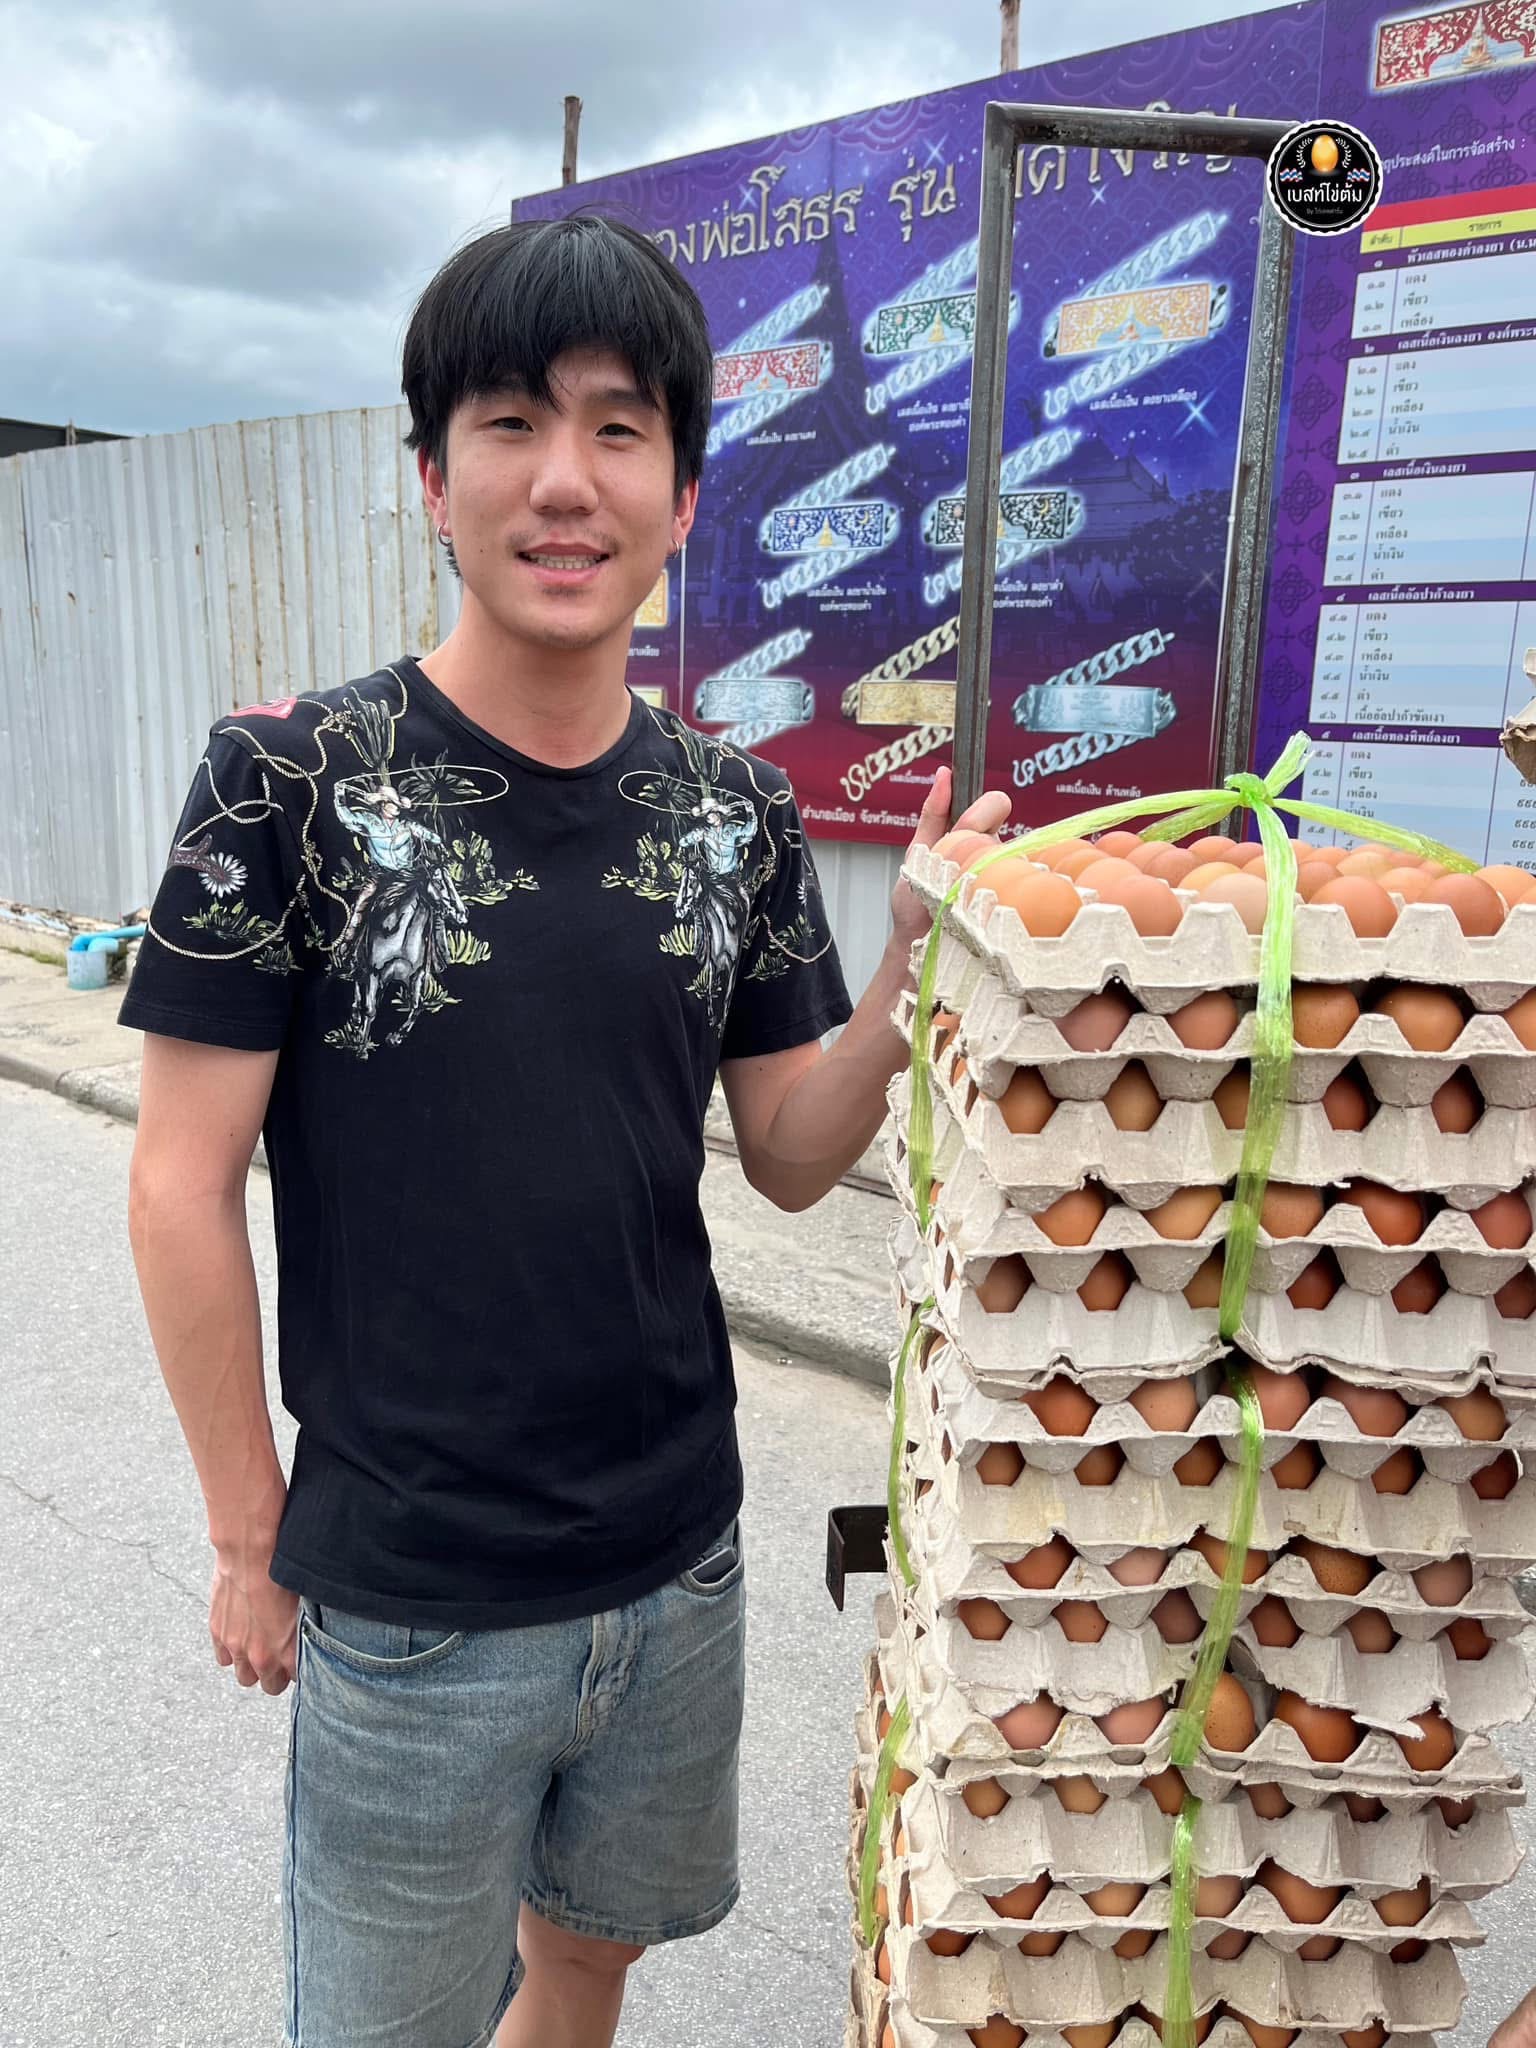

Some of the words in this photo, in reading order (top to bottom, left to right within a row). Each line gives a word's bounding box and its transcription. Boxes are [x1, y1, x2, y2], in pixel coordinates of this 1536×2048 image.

[643, 164, 864, 264] วงพ่อโสธร
[888, 157, 957, 243] รุ่น
[860, 809, 921, 828] จังหวัดฉะเชิ
